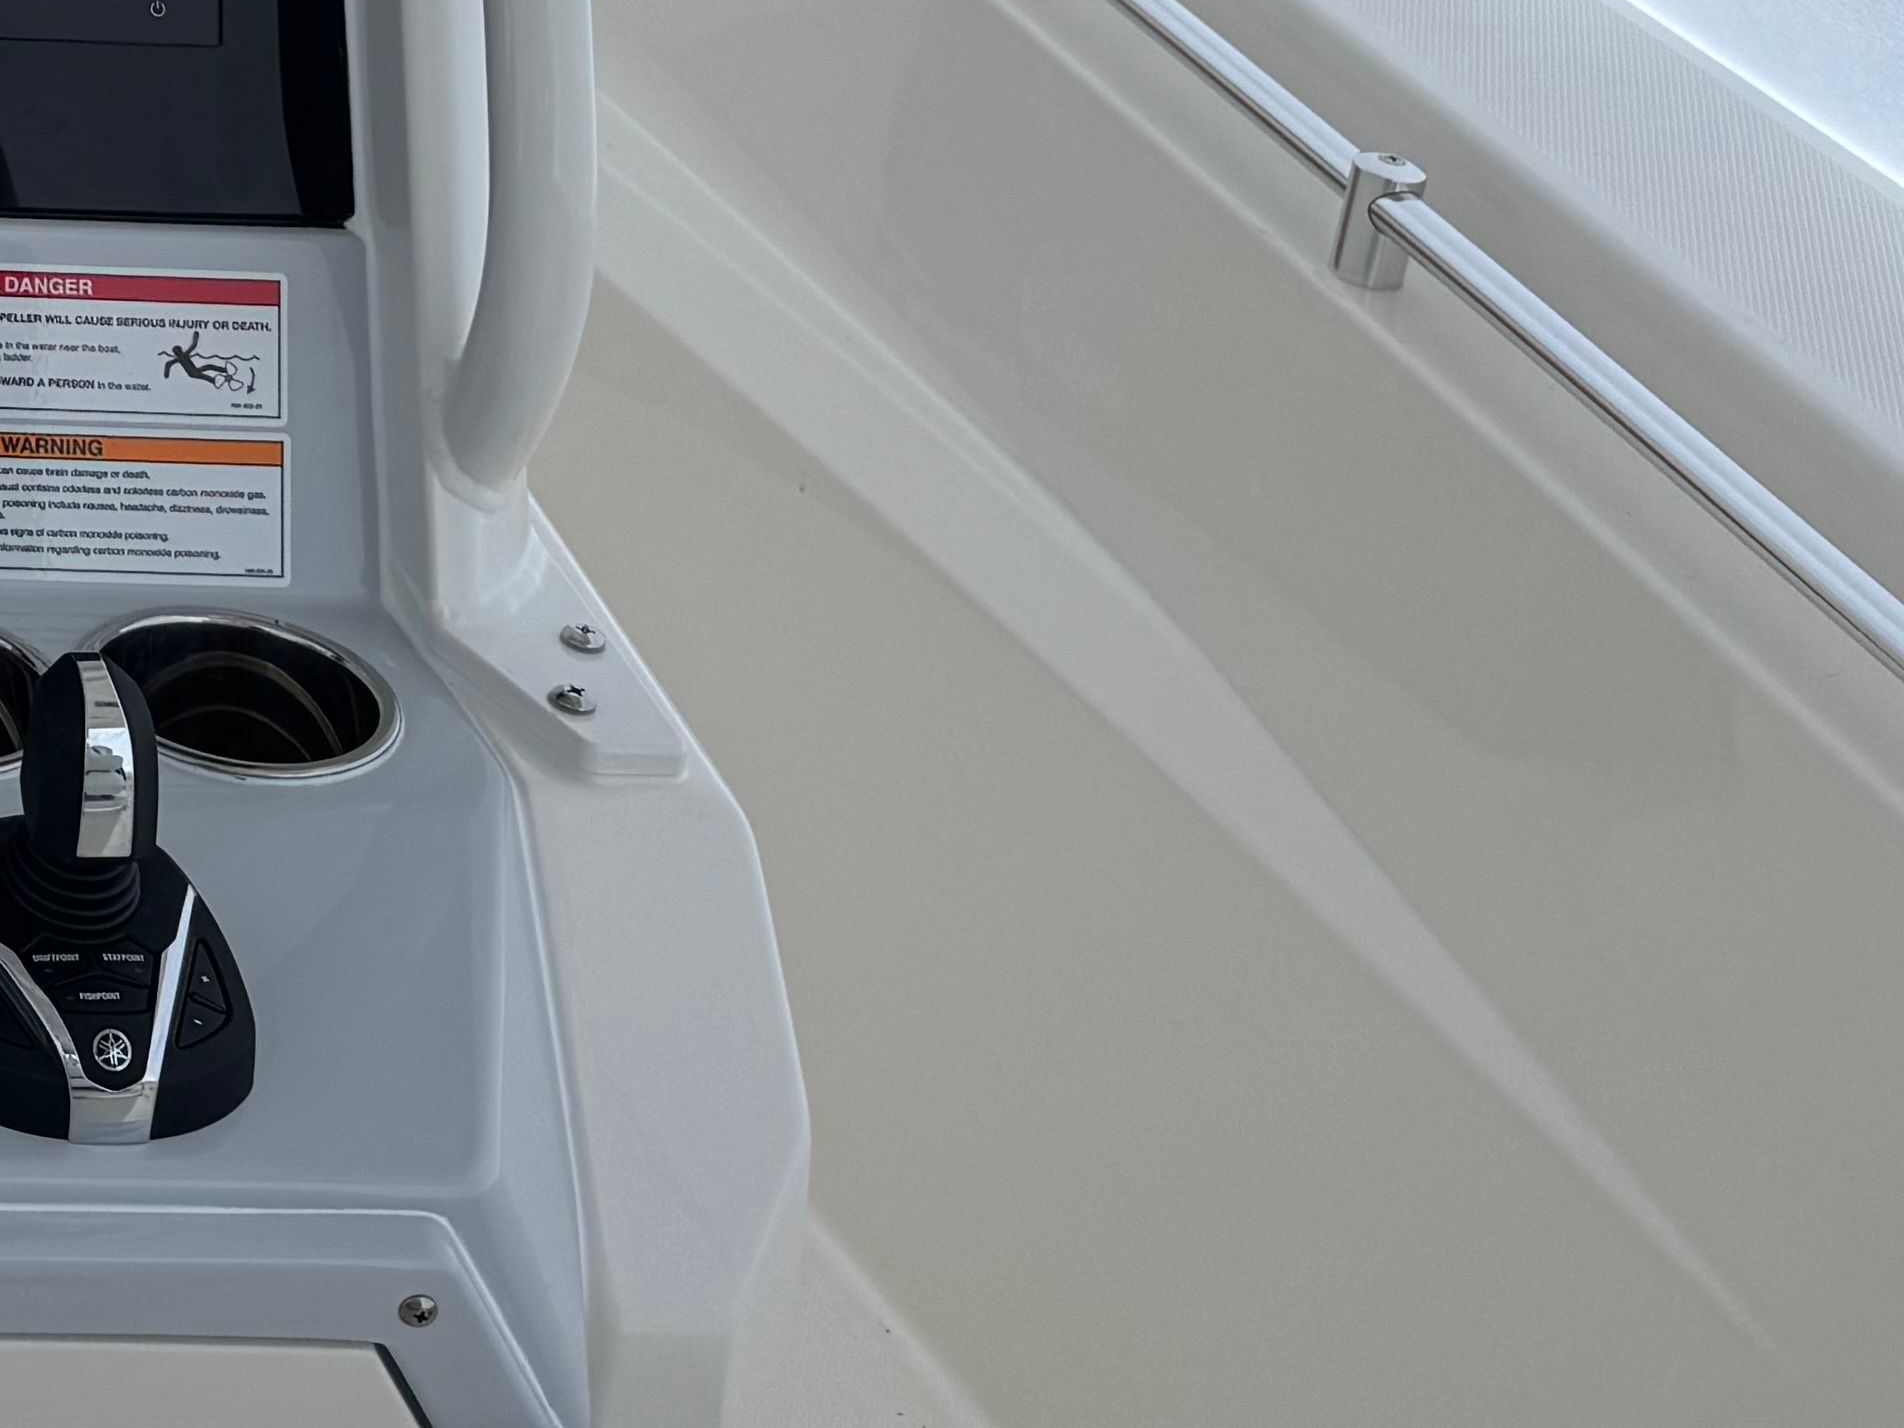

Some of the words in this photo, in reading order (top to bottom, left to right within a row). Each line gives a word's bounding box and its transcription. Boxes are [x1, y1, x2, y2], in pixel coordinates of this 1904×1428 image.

[4, 276, 94, 295] DANGER
[212, 320, 229, 331] OR
[37, 377, 45, 387] A
[48, 378, 94, 390] PERSON
[0, 436, 104, 457] WARNING
